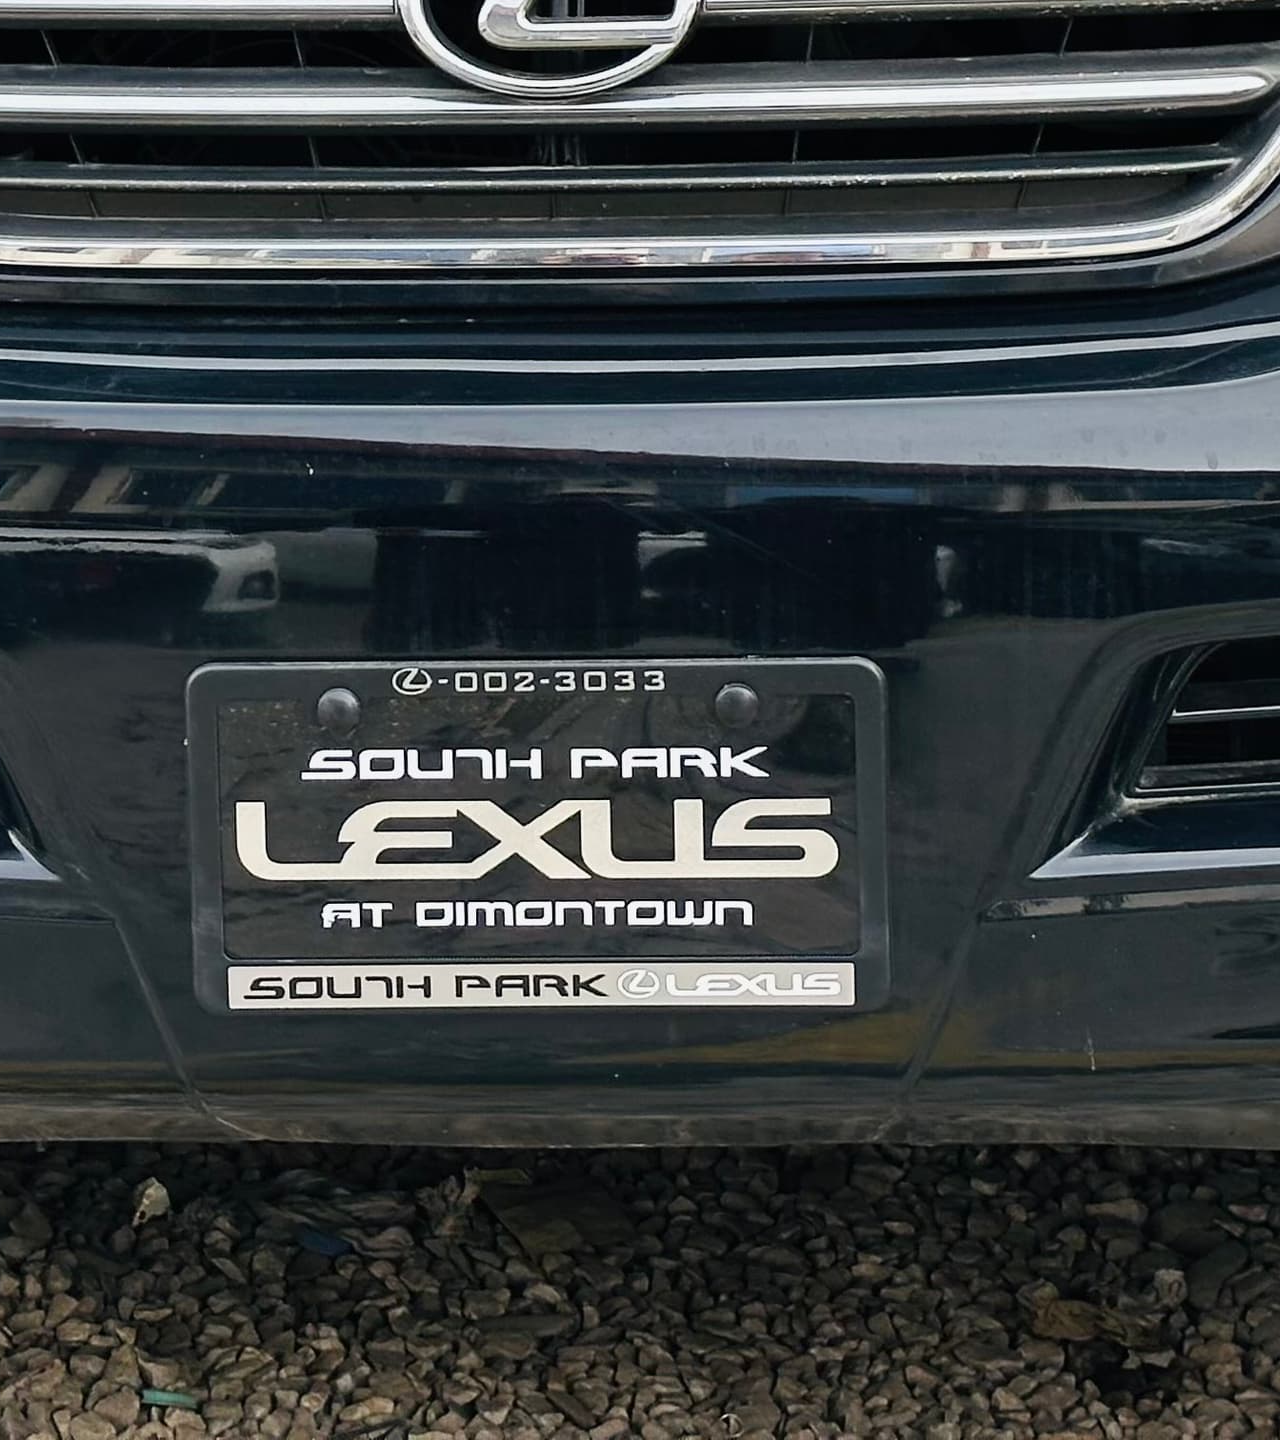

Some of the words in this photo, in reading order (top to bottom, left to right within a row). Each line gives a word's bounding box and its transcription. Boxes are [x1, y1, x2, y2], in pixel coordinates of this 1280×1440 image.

[301, 748, 542, 781] SOUTH
[570, 746, 770, 779] PARK
[235, 797, 839, 881] LEXUS
[321, 902, 393, 929] AT
[415, 900, 753, 927] DIMONTOWN
[243, 975, 432, 1000] SOUTH
[454, 973, 609, 998] PARK
[666, 972, 842, 997] LEXUS
